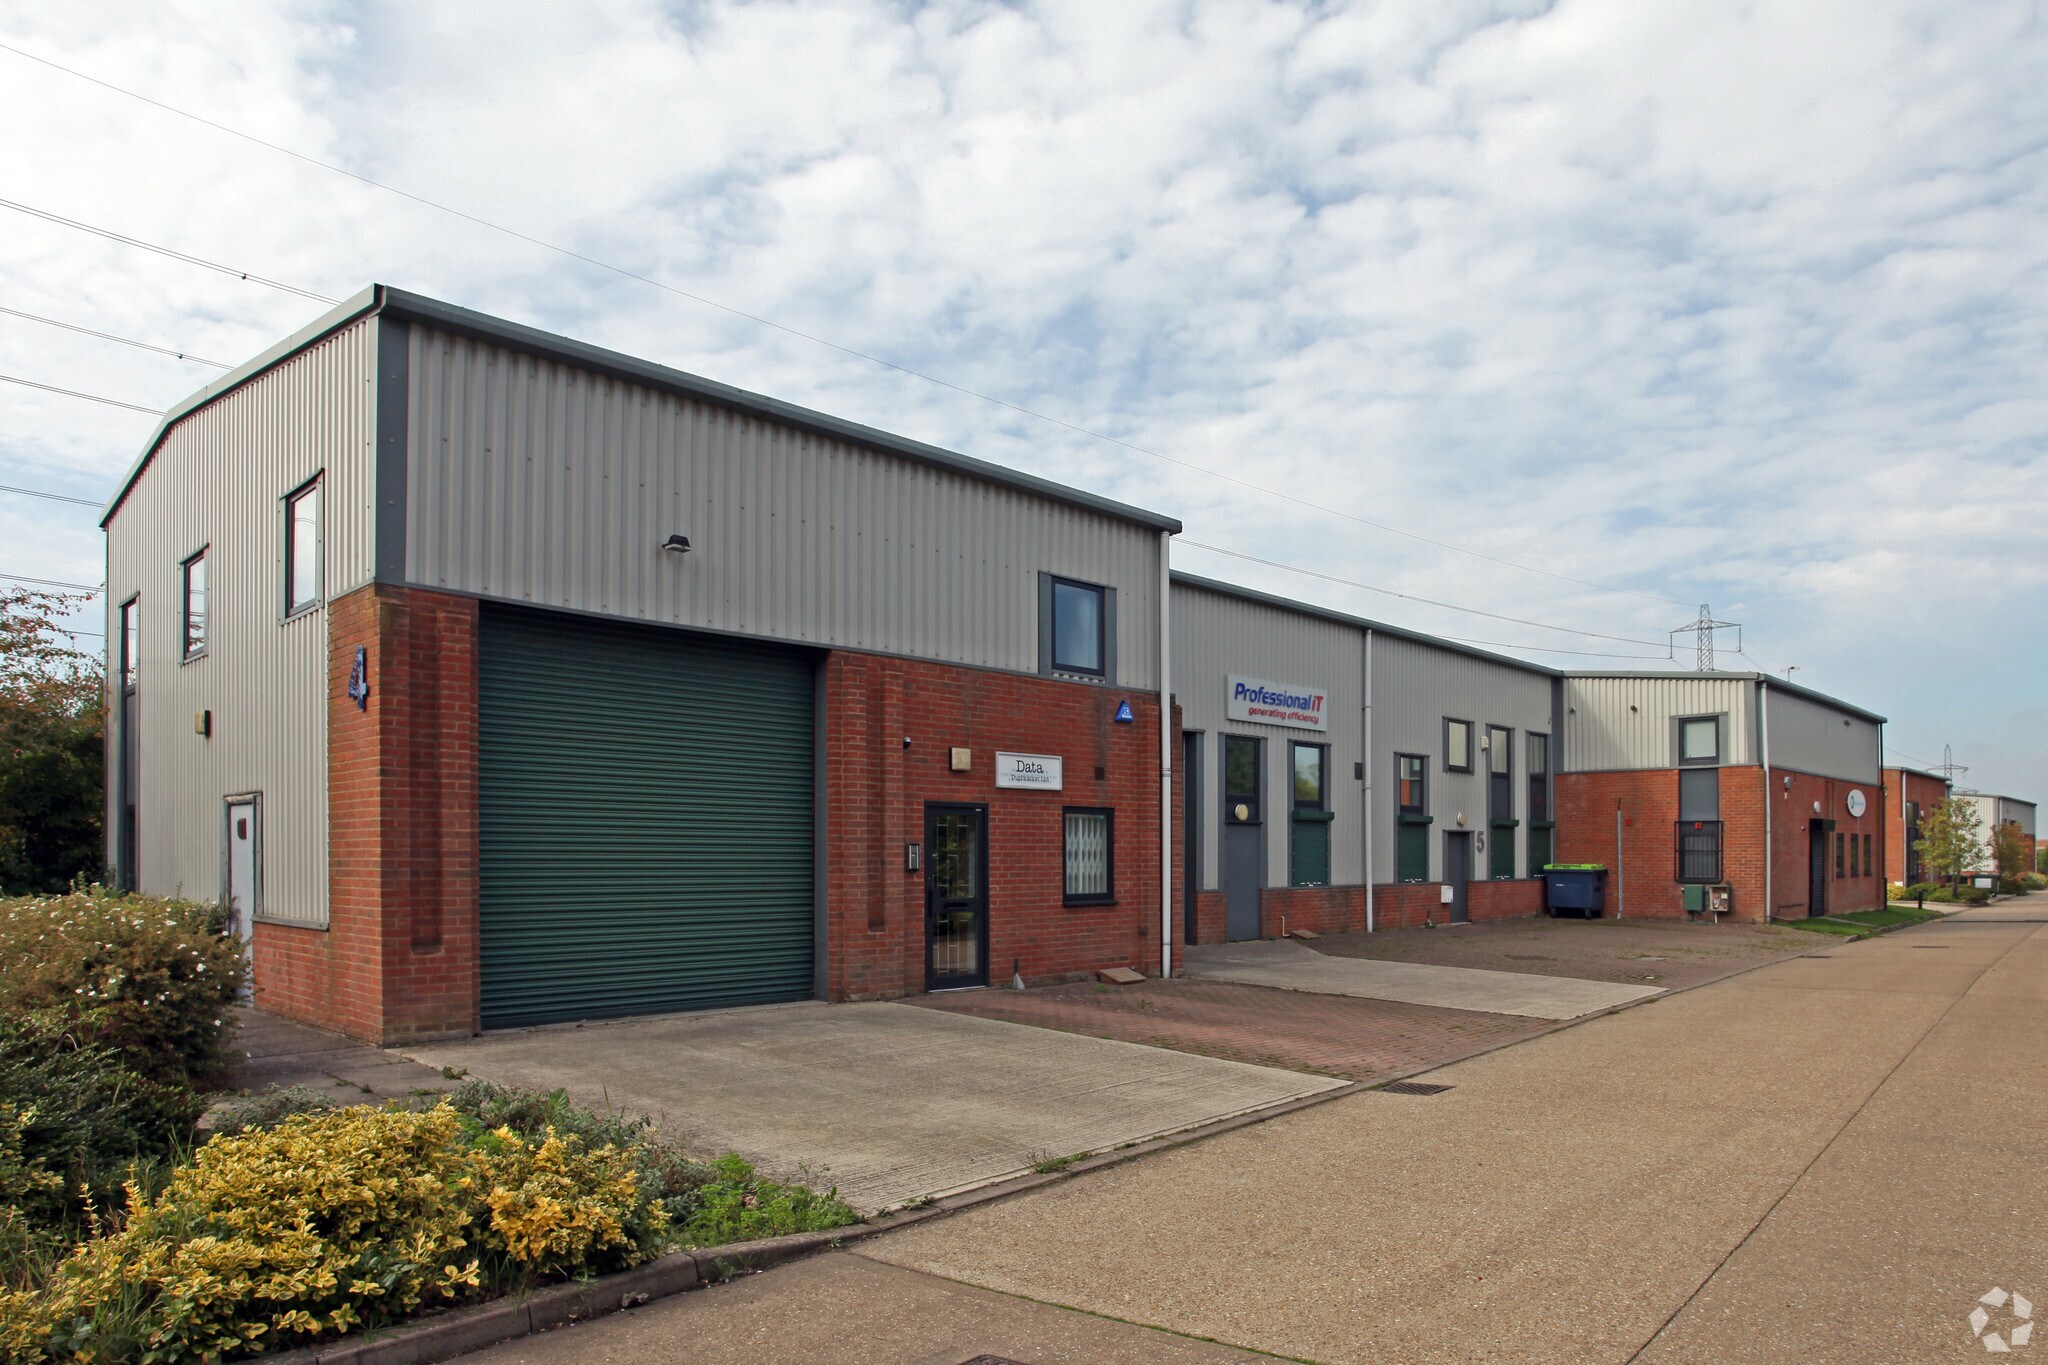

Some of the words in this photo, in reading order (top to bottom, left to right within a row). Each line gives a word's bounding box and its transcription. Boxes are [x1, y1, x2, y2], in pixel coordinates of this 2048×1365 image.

[348, 643, 367, 711] 4
[1248, 706, 1287, 720] generating
[1287, 711, 1320, 725] efficiency
[1016, 759, 1044, 774] Data
[1476, 830, 1485, 853] 5
